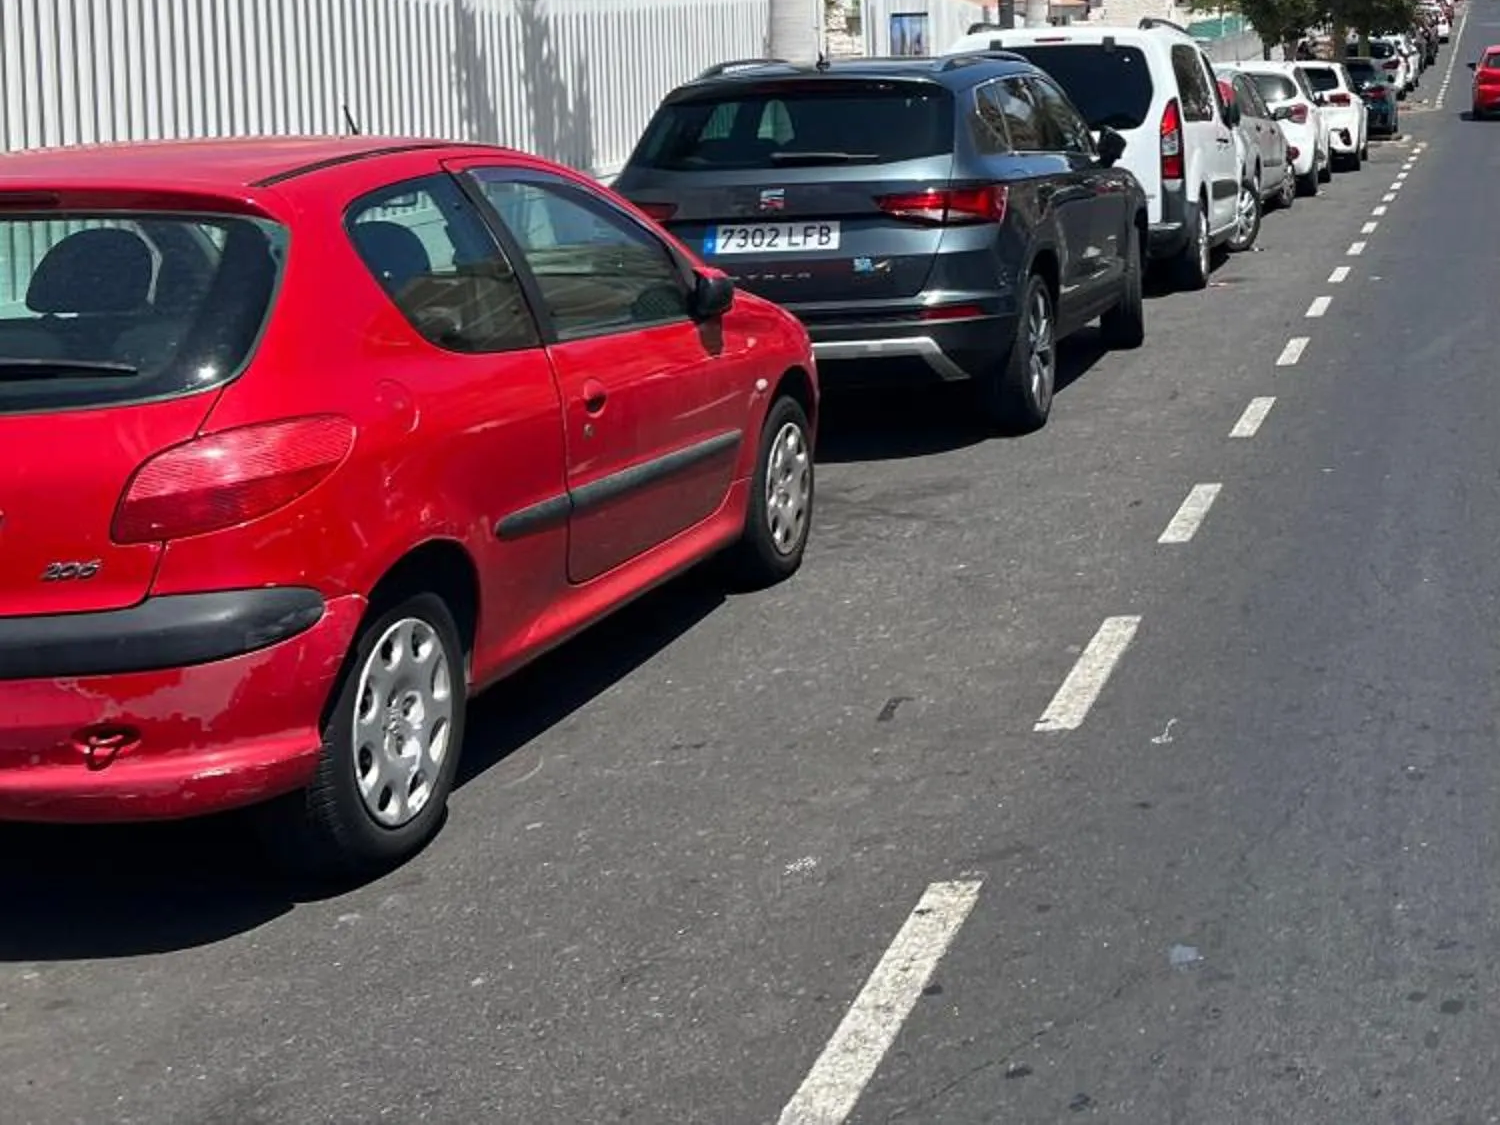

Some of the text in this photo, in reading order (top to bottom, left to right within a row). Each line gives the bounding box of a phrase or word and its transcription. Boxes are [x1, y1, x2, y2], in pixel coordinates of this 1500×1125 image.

[721, 224, 832, 250] 7302 LFB
[40, 559, 101, 581] 206
